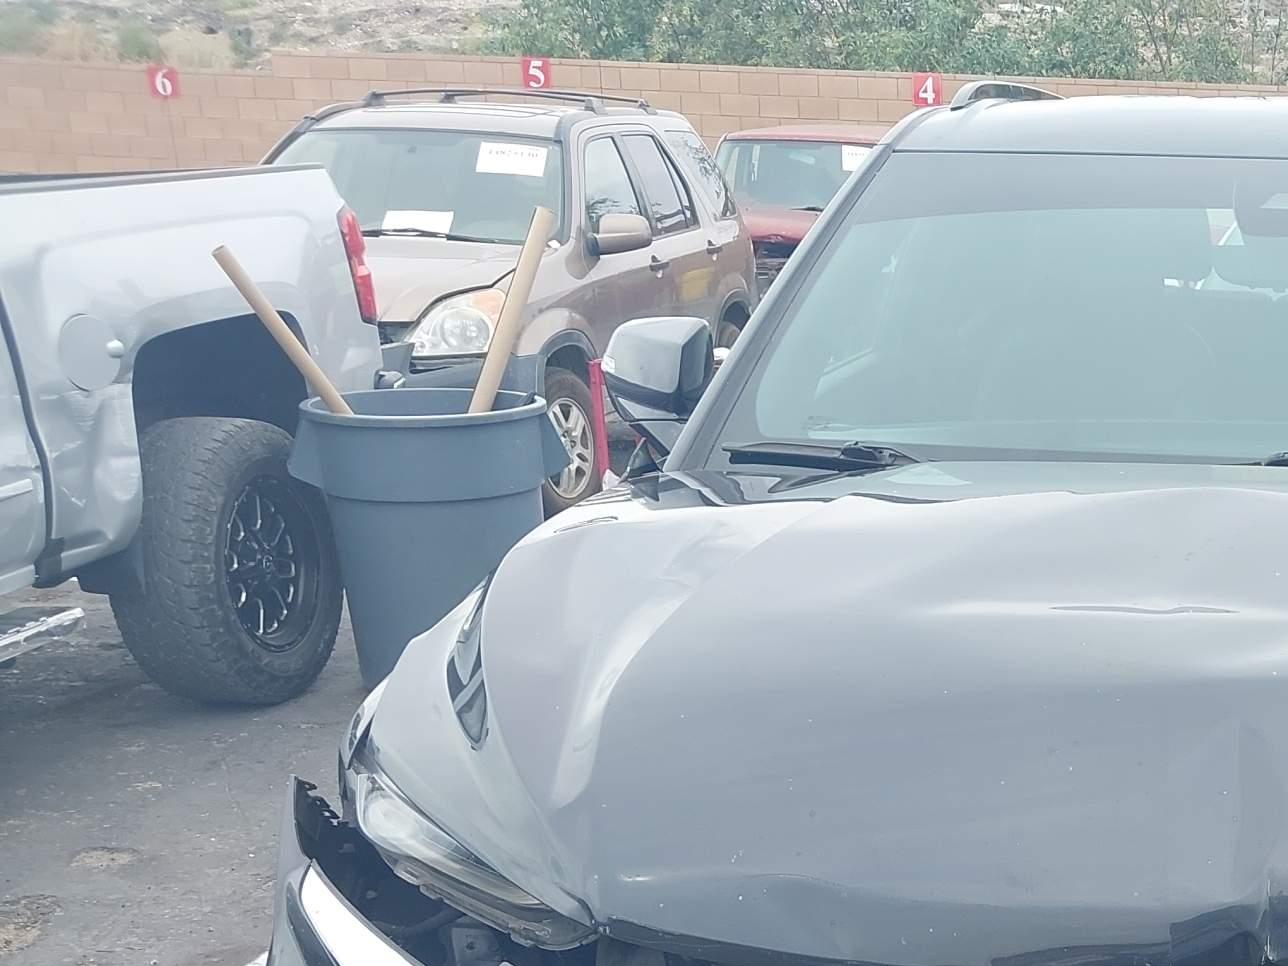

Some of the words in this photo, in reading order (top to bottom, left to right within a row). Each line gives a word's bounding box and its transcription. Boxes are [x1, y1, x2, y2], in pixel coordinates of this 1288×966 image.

[155, 69, 173, 96] 6
[528, 60, 545, 88] 5
[918, 76, 936, 104] 4
